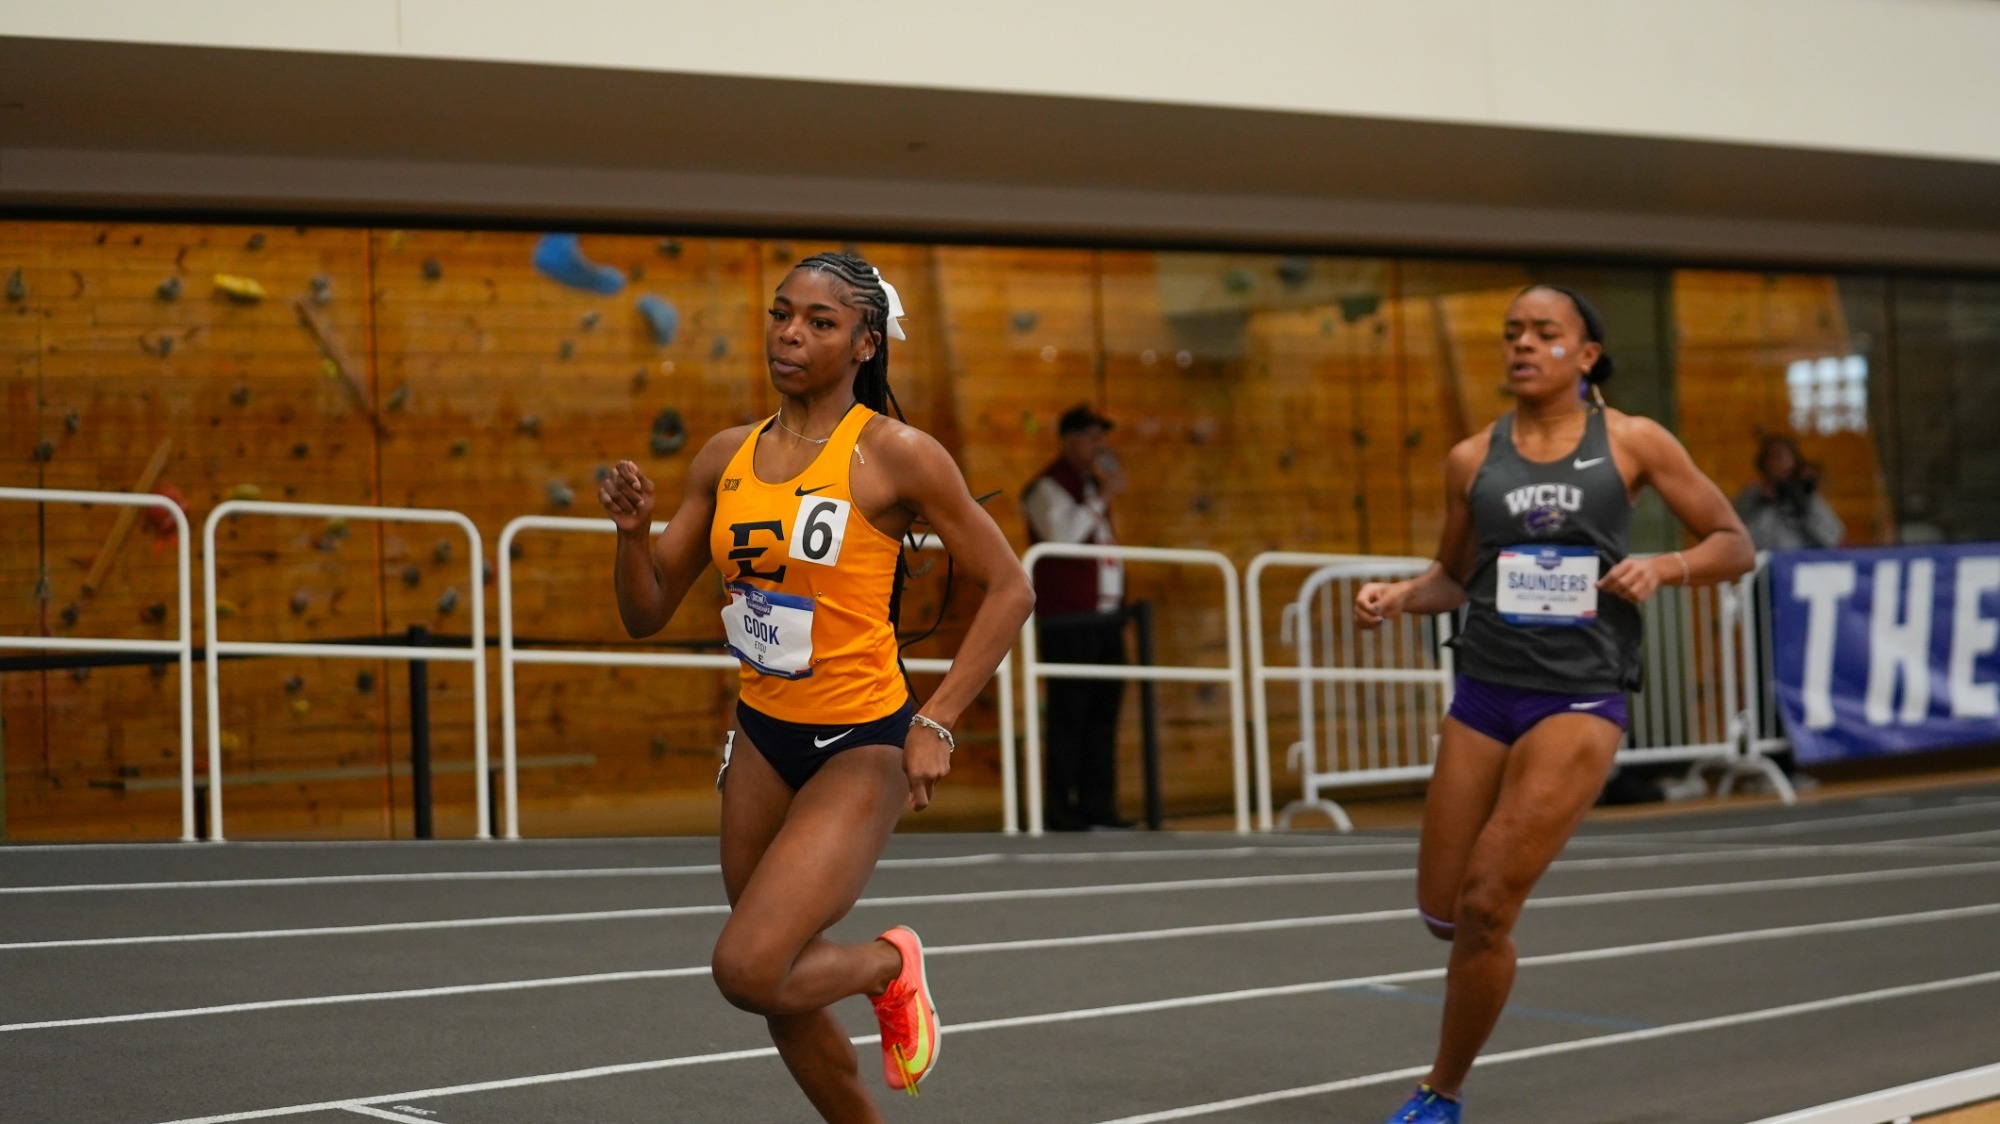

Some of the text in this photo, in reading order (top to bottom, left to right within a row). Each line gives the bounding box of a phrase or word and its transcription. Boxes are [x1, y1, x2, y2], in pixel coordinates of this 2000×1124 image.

[1505, 485, 1583, 515] WCU
[729, 520, 787, 583] E
[802, 501, 838, 560] 6
[1508, 572, 1588, 592] SAUNDERS
[744, 614, 780, 645] COOK
[1793, 556, 2000, 731] THE
